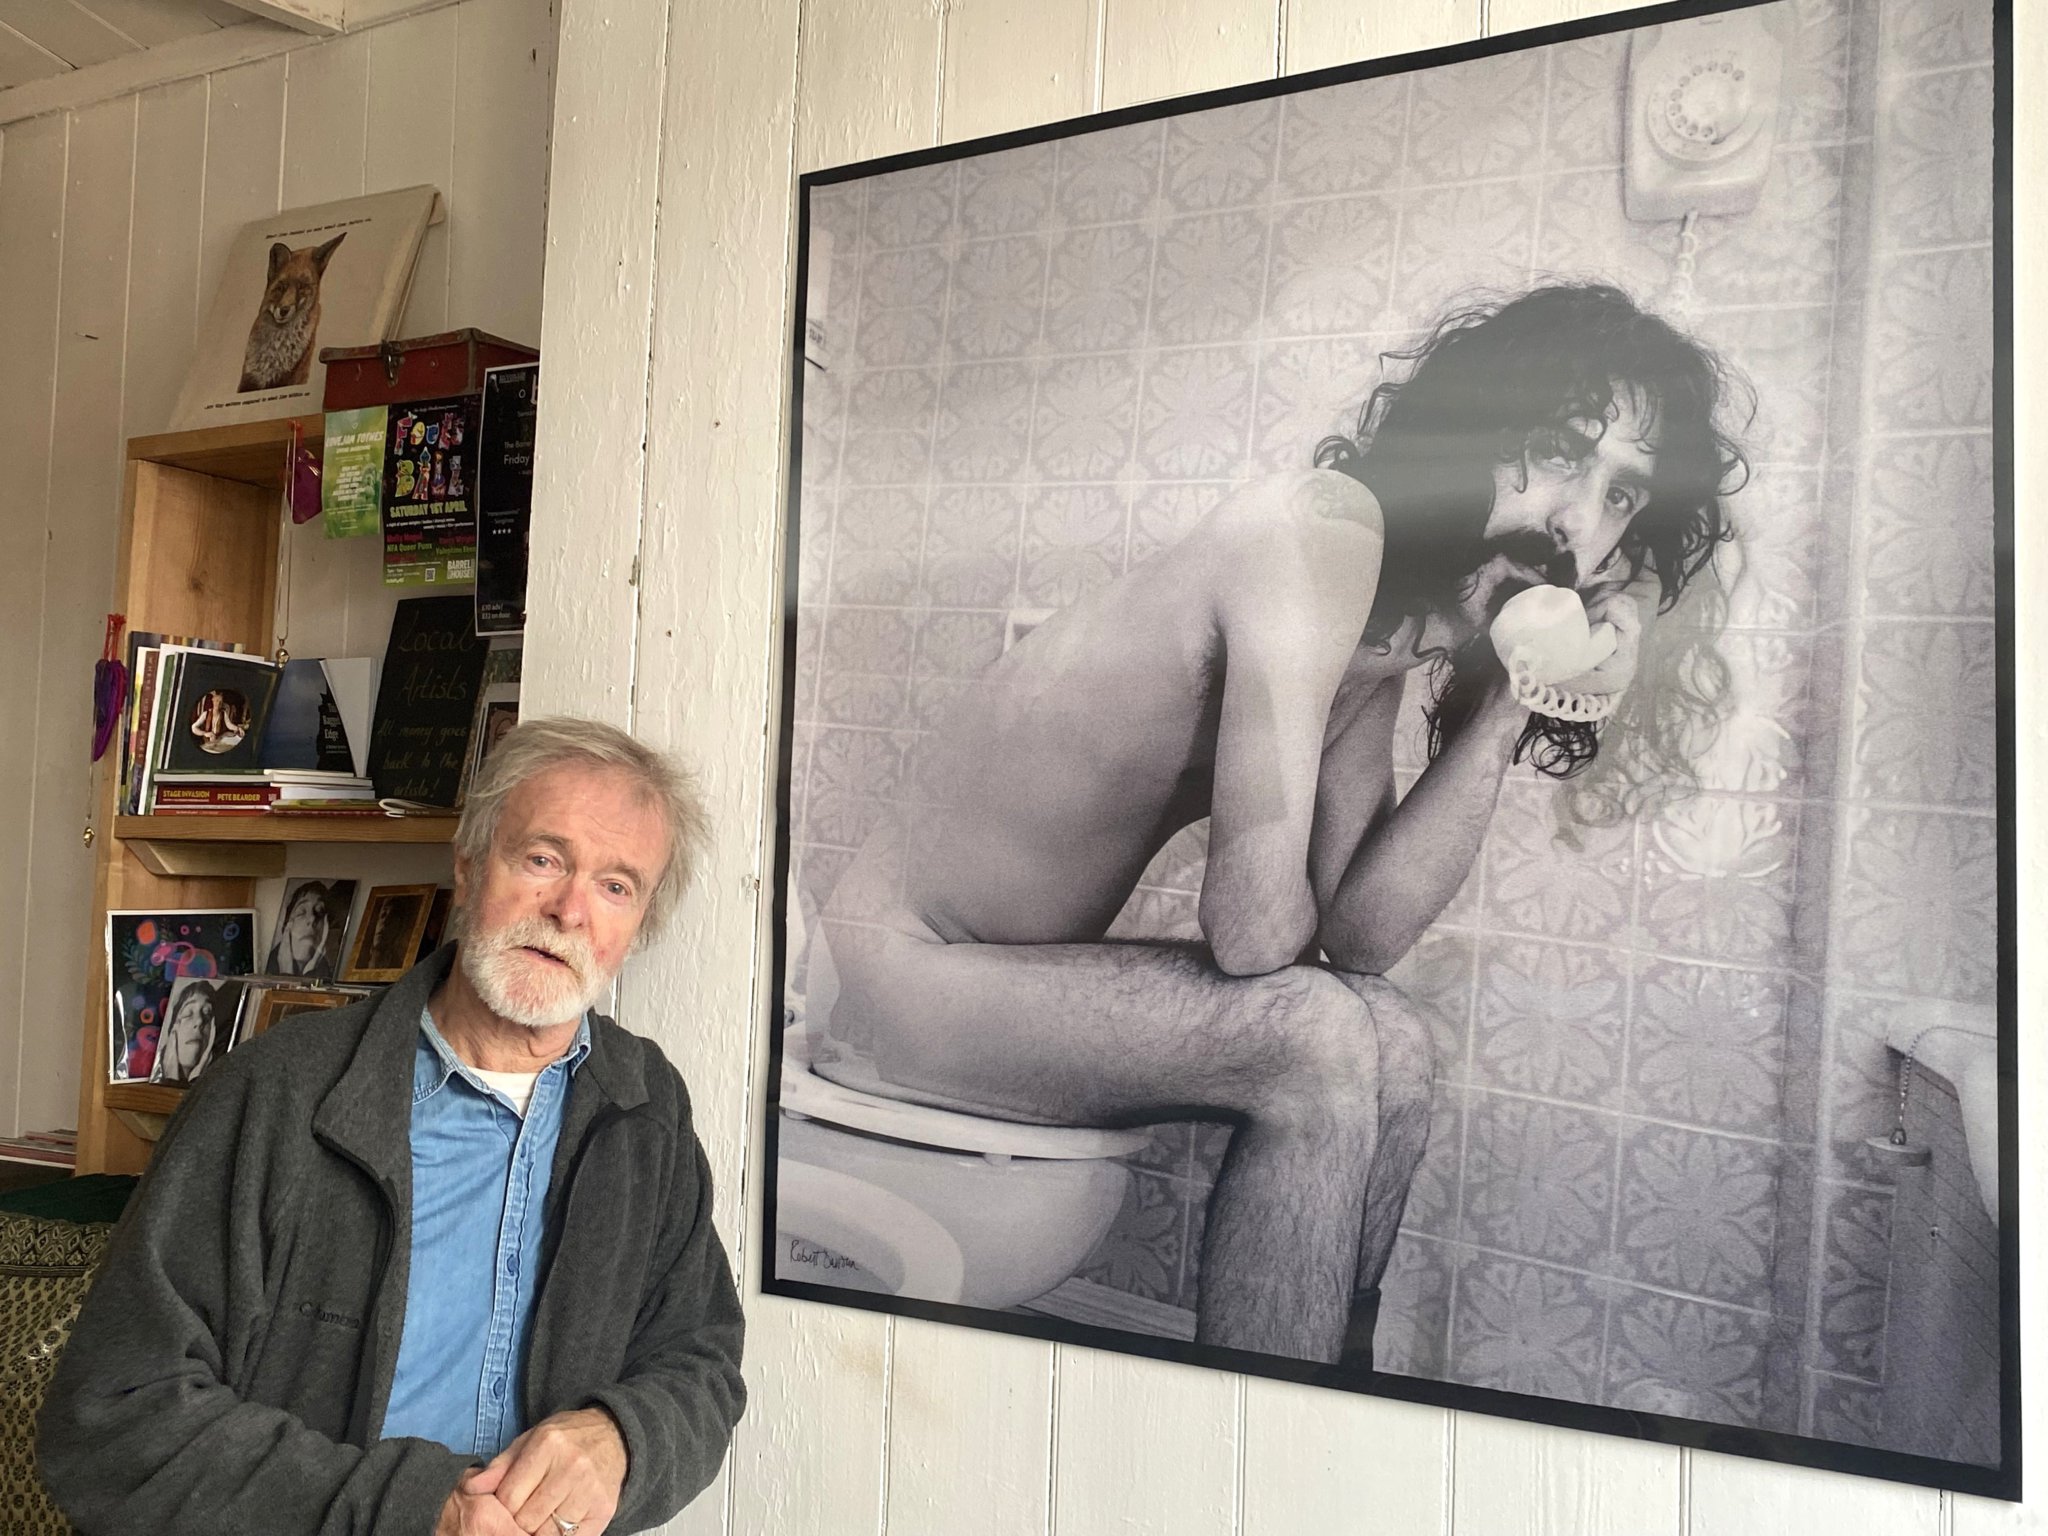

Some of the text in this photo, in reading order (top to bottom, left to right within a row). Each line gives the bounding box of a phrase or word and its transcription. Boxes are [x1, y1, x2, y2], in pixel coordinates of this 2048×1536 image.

[503, 452, 530, 466] Friday
[389, 503, 429, 519] SATURDAY
[429, 502, 444, 515] 1ST
[444, 500, 468, 513] APRIL
[447, 559, 472, 570] BARREL
[451, 569, 471, 580] HOUSE
[398, 610, 476, 652] Local
[399, 664, 469, 706] Artists
[383, 751, 414, 770] back
[162, 790, 182, 798] STAGE
[181, 790, 210, 799] INVASION
[217, 793, 233, 801] PETE
[232, 793, 261, 801] BEARDER
